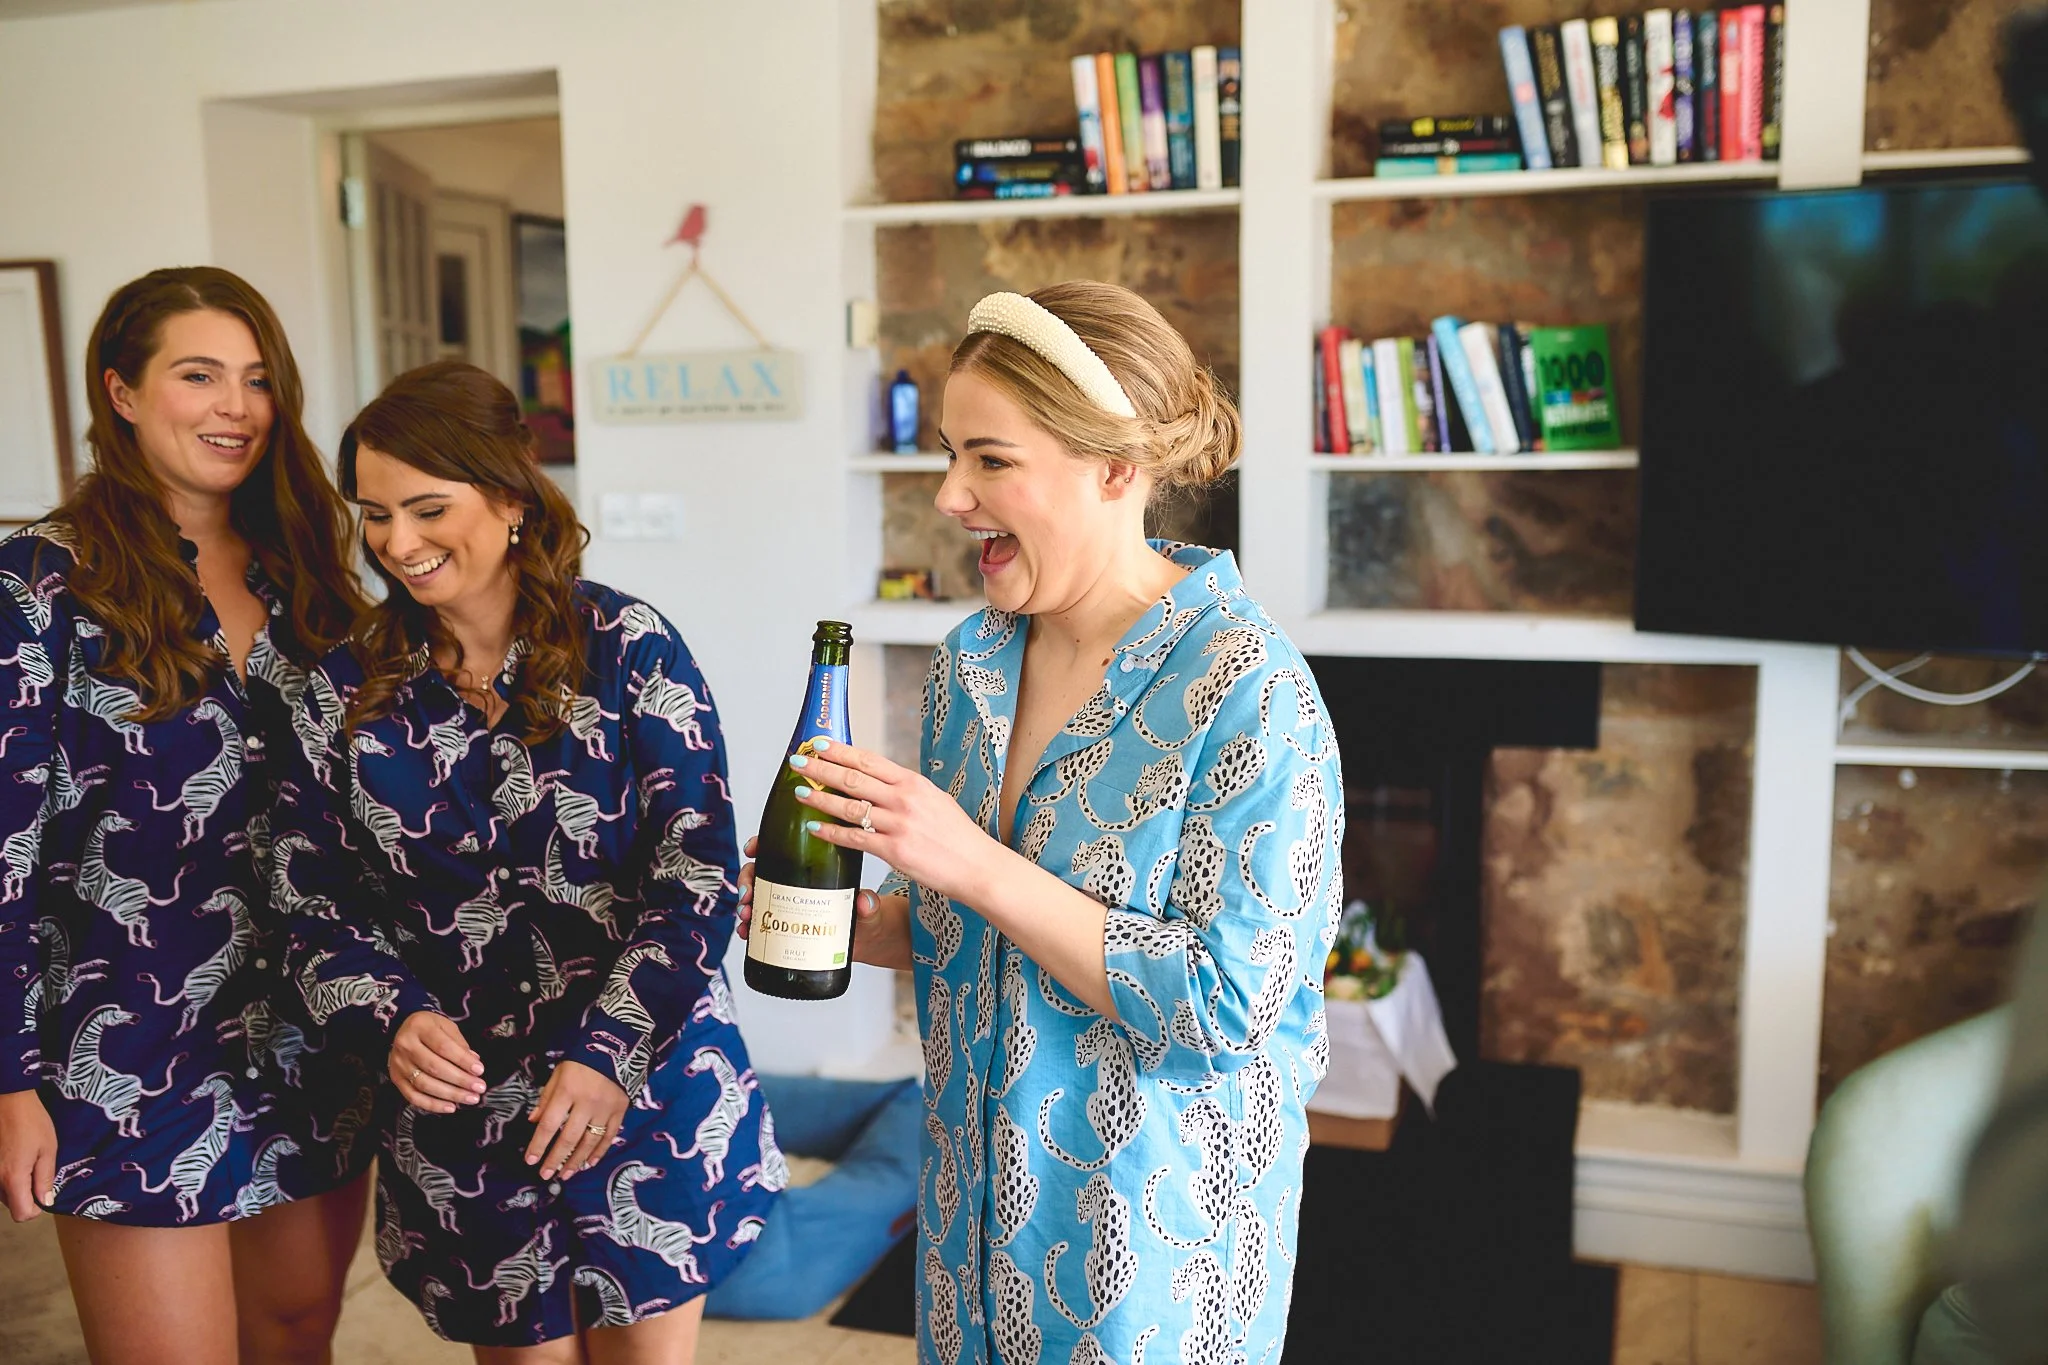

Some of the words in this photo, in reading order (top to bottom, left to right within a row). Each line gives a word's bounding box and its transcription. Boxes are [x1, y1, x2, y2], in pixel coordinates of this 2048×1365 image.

[607, 360, 782, 401] RELAX
[772, 893, 791, 903] GRAN
[793, 897, 831, 906] CREMANT
